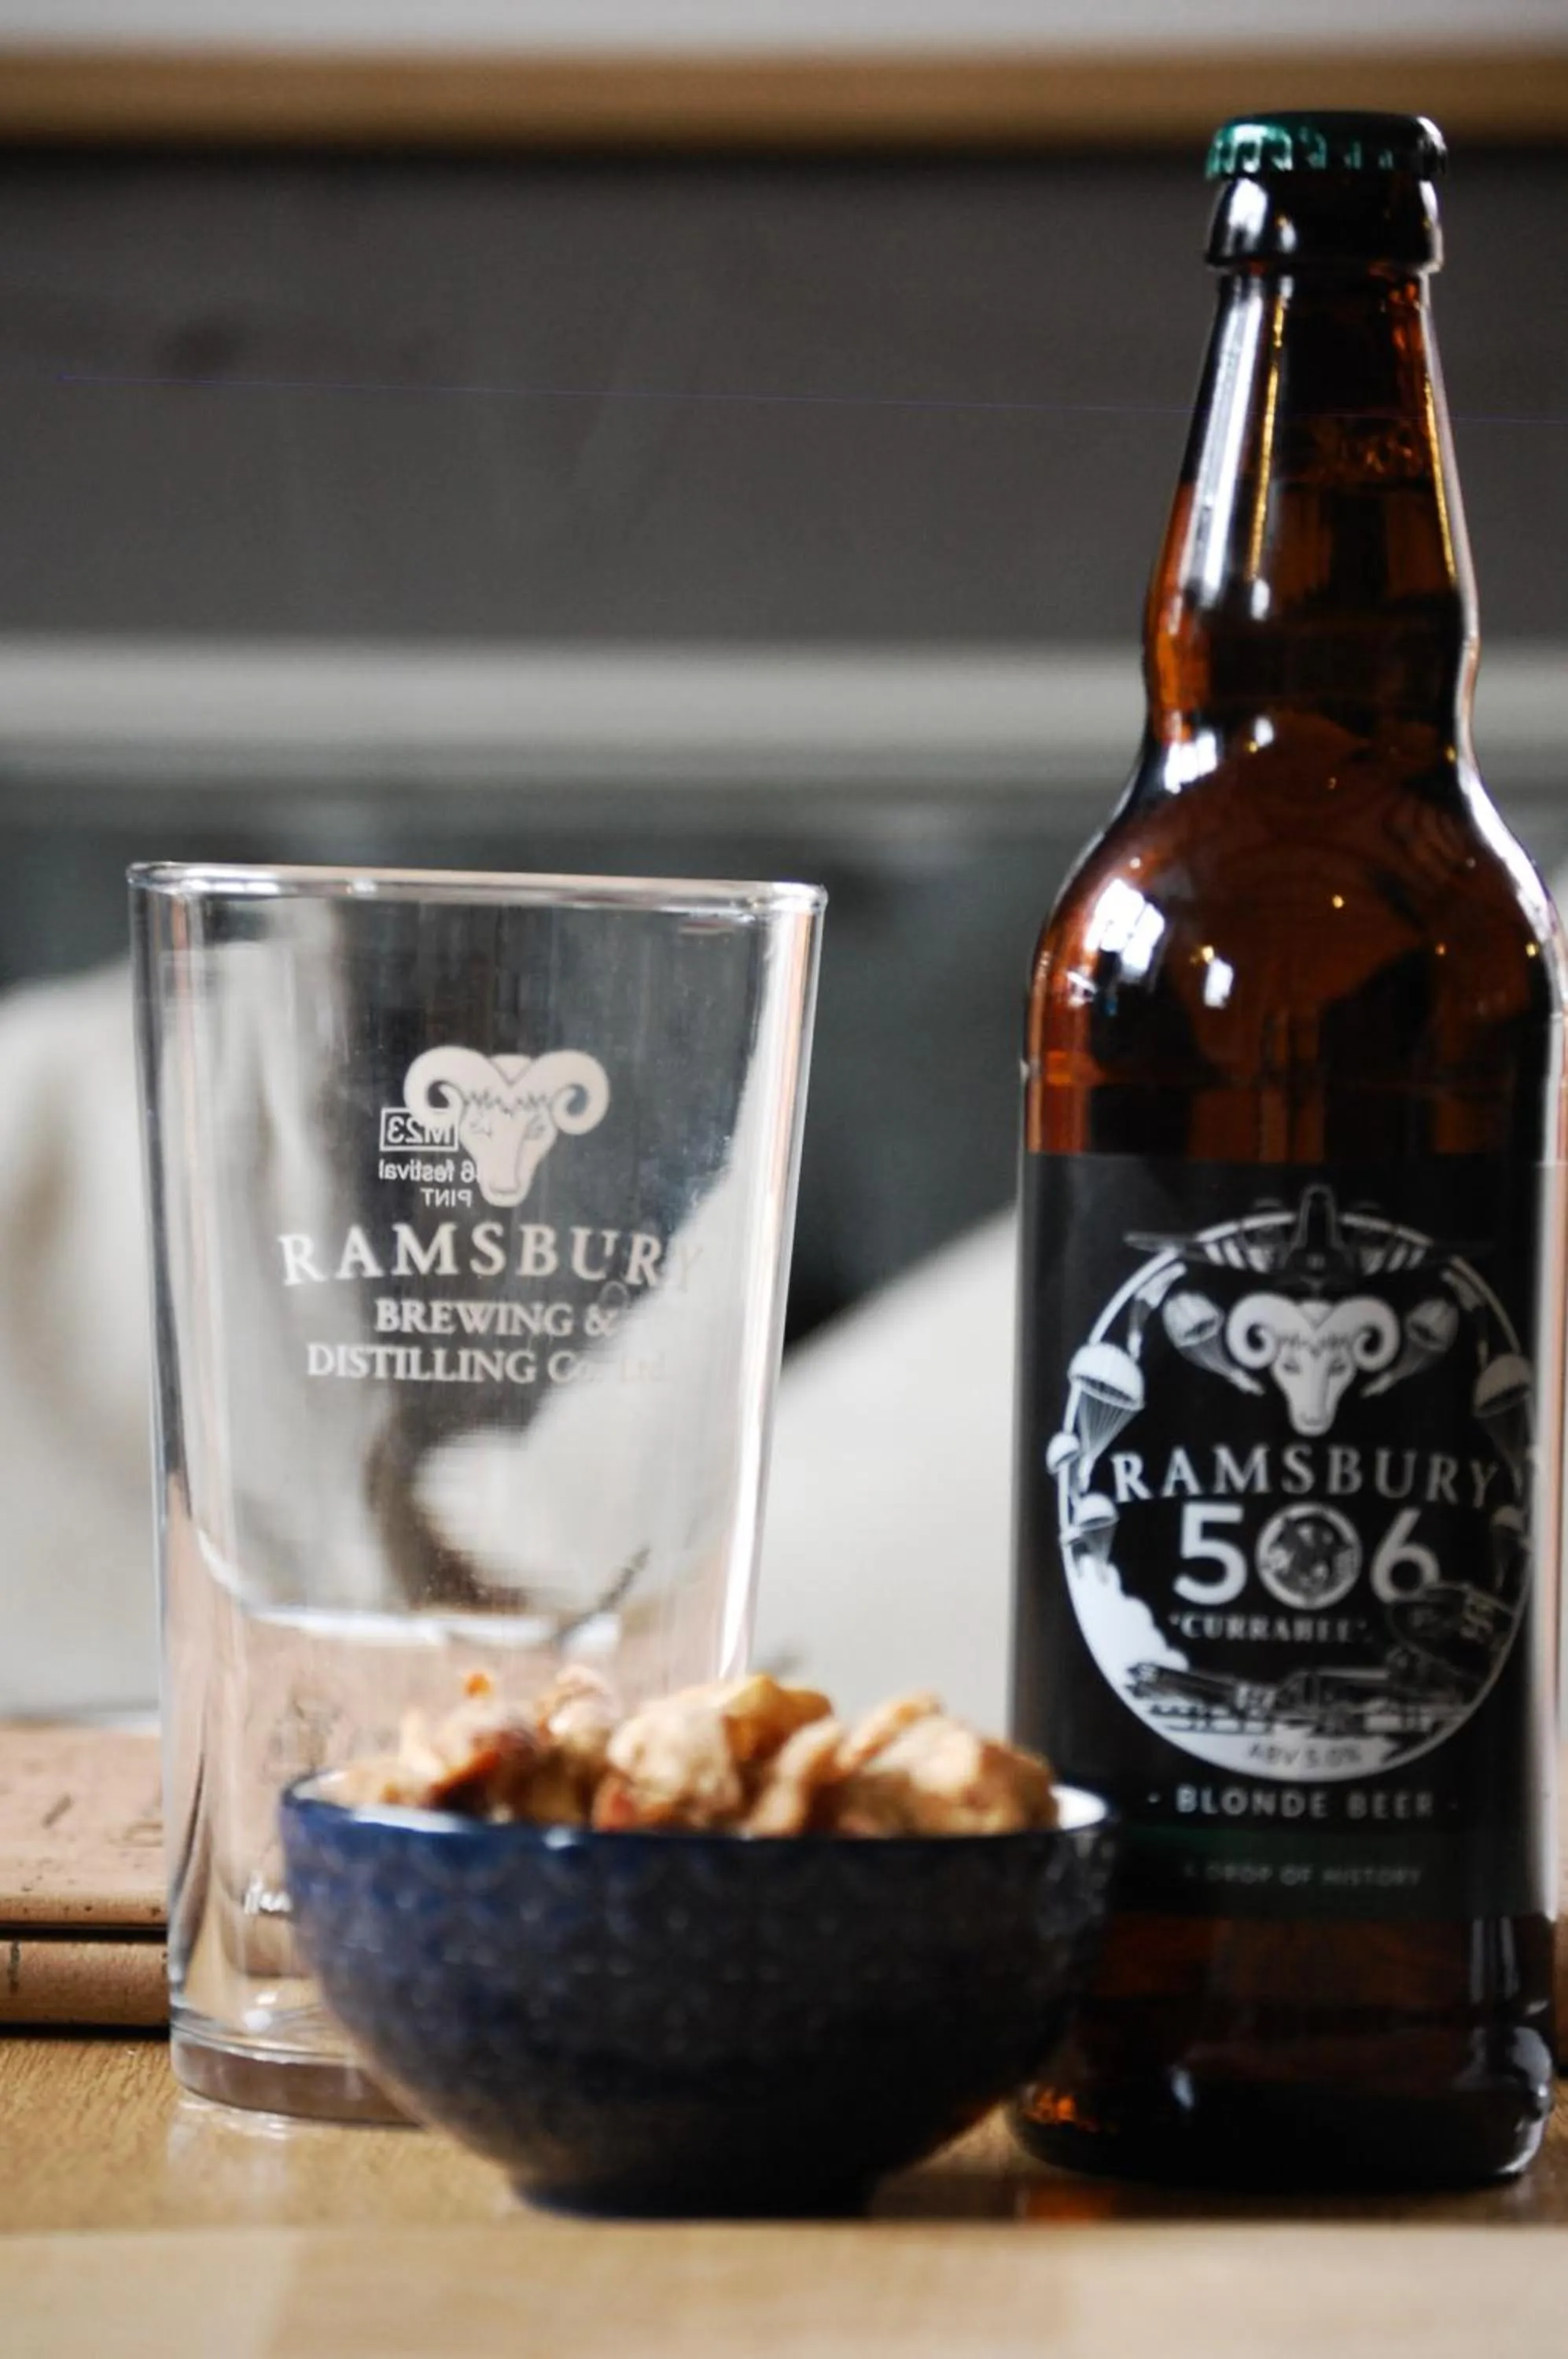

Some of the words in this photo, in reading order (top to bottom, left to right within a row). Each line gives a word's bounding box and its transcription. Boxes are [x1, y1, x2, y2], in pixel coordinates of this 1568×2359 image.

[375, 1297, 574, 1337] BREWING
[583, 1302, 618, 1337] &
[307, 1343, 537, 1384] DISTILLING
[1111, 1442, 1498, 1509] RAMSBURY
[1176, 1786, 1329, 1818] BLONDE
[1345, 1790, 1434, 1820] BEER
